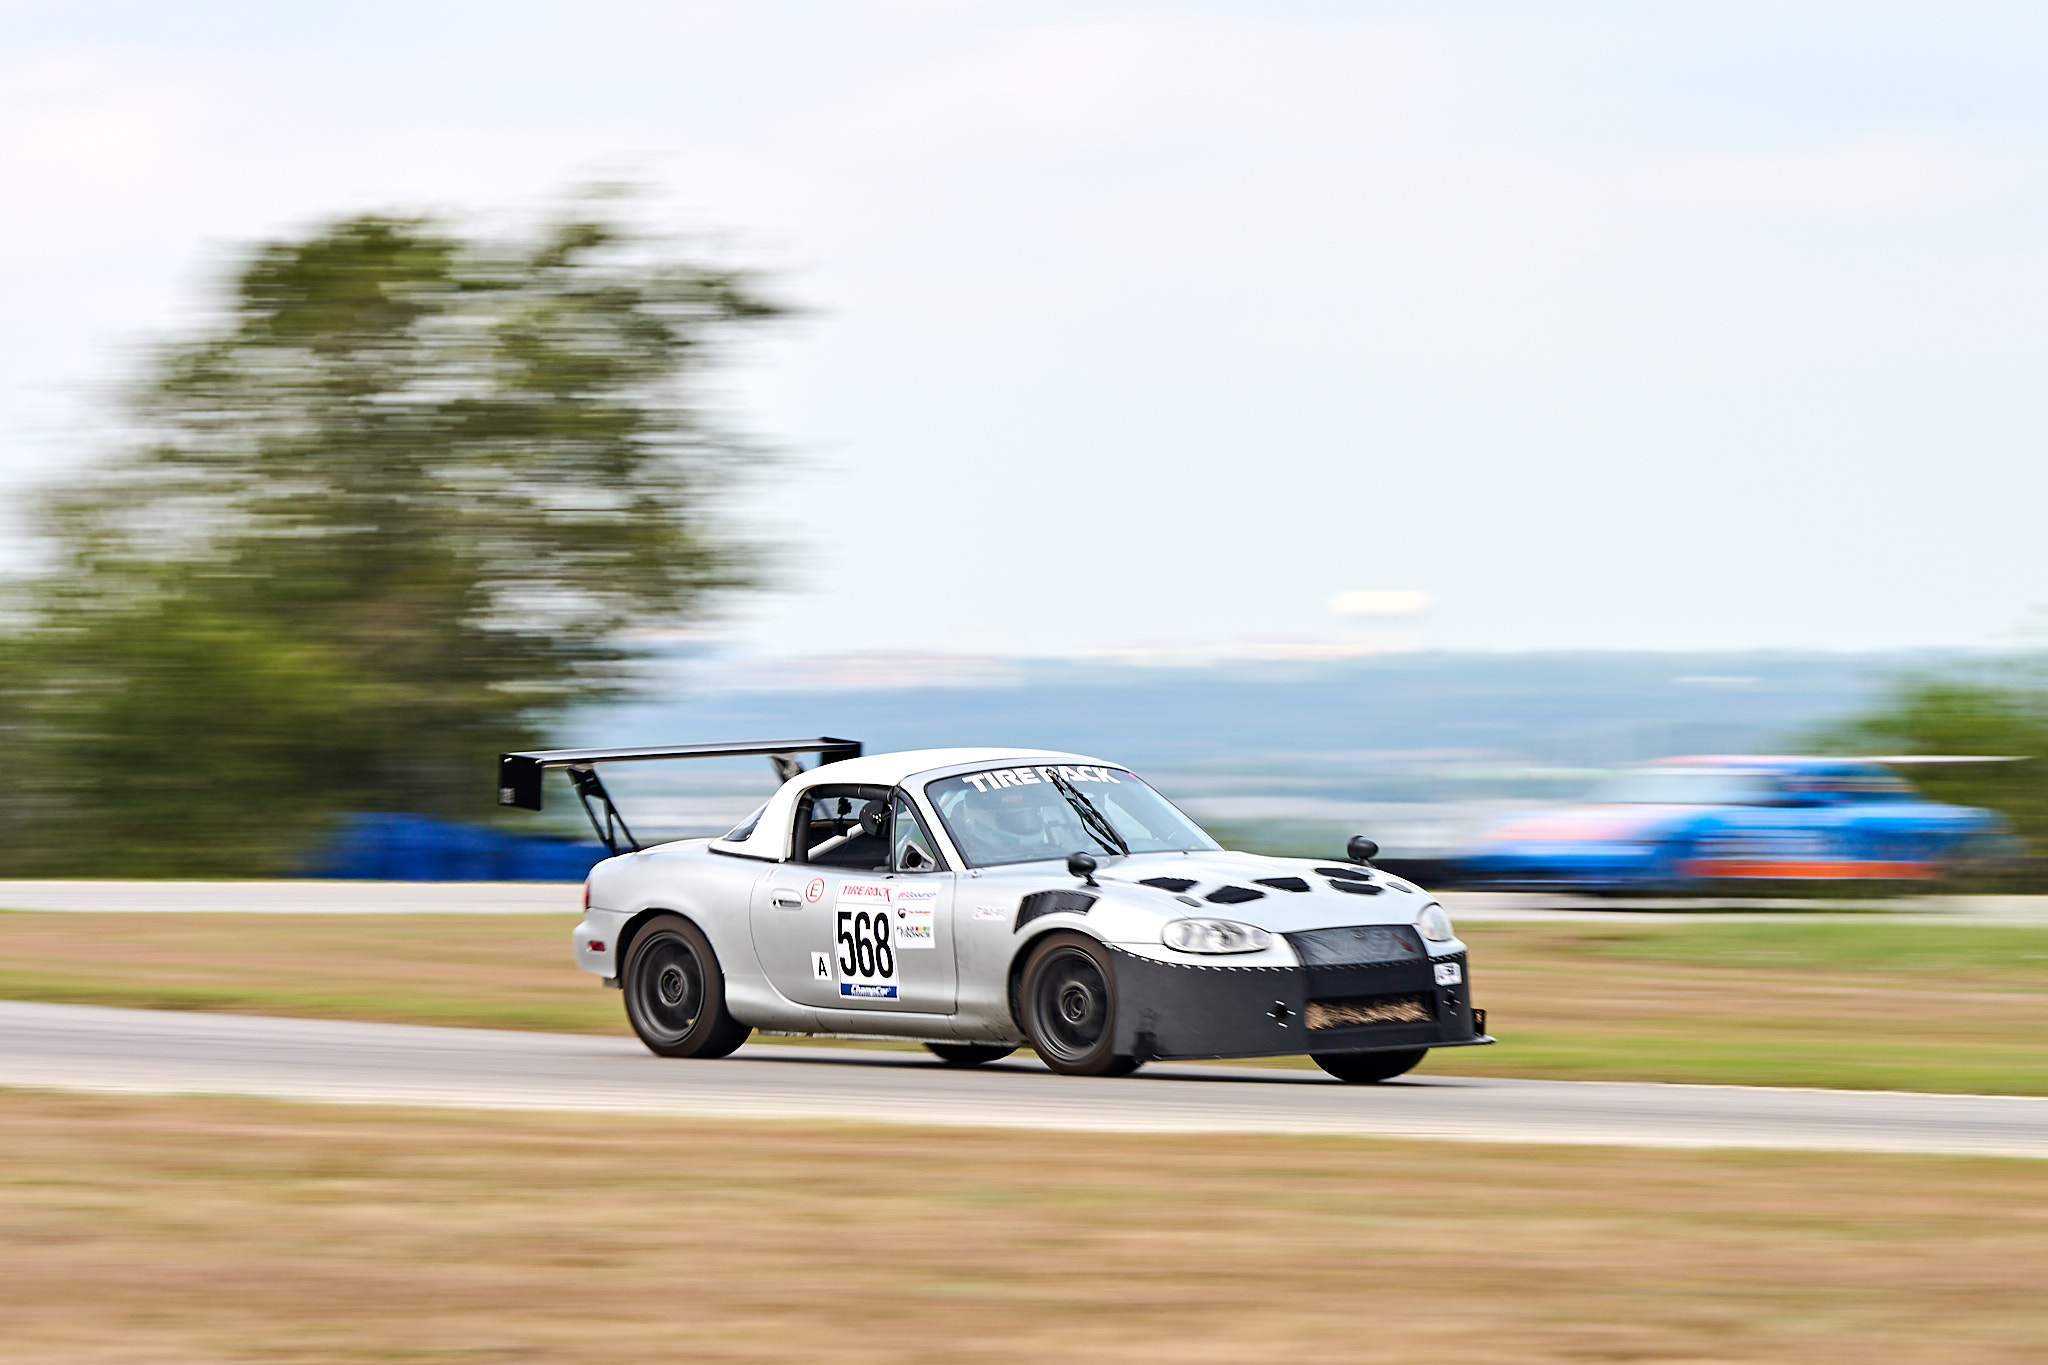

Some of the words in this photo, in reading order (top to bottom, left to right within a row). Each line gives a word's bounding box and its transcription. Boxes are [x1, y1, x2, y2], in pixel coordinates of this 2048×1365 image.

[962, 767, 1041, 793] TIRE
[1035, 765, 1121, 784] RACK
[842, 885, 865, 896] TIRE
[864, 886, 892, 903] RACK
[837, 911, 894, 979] 568
[818, 956, 828, 977] A
